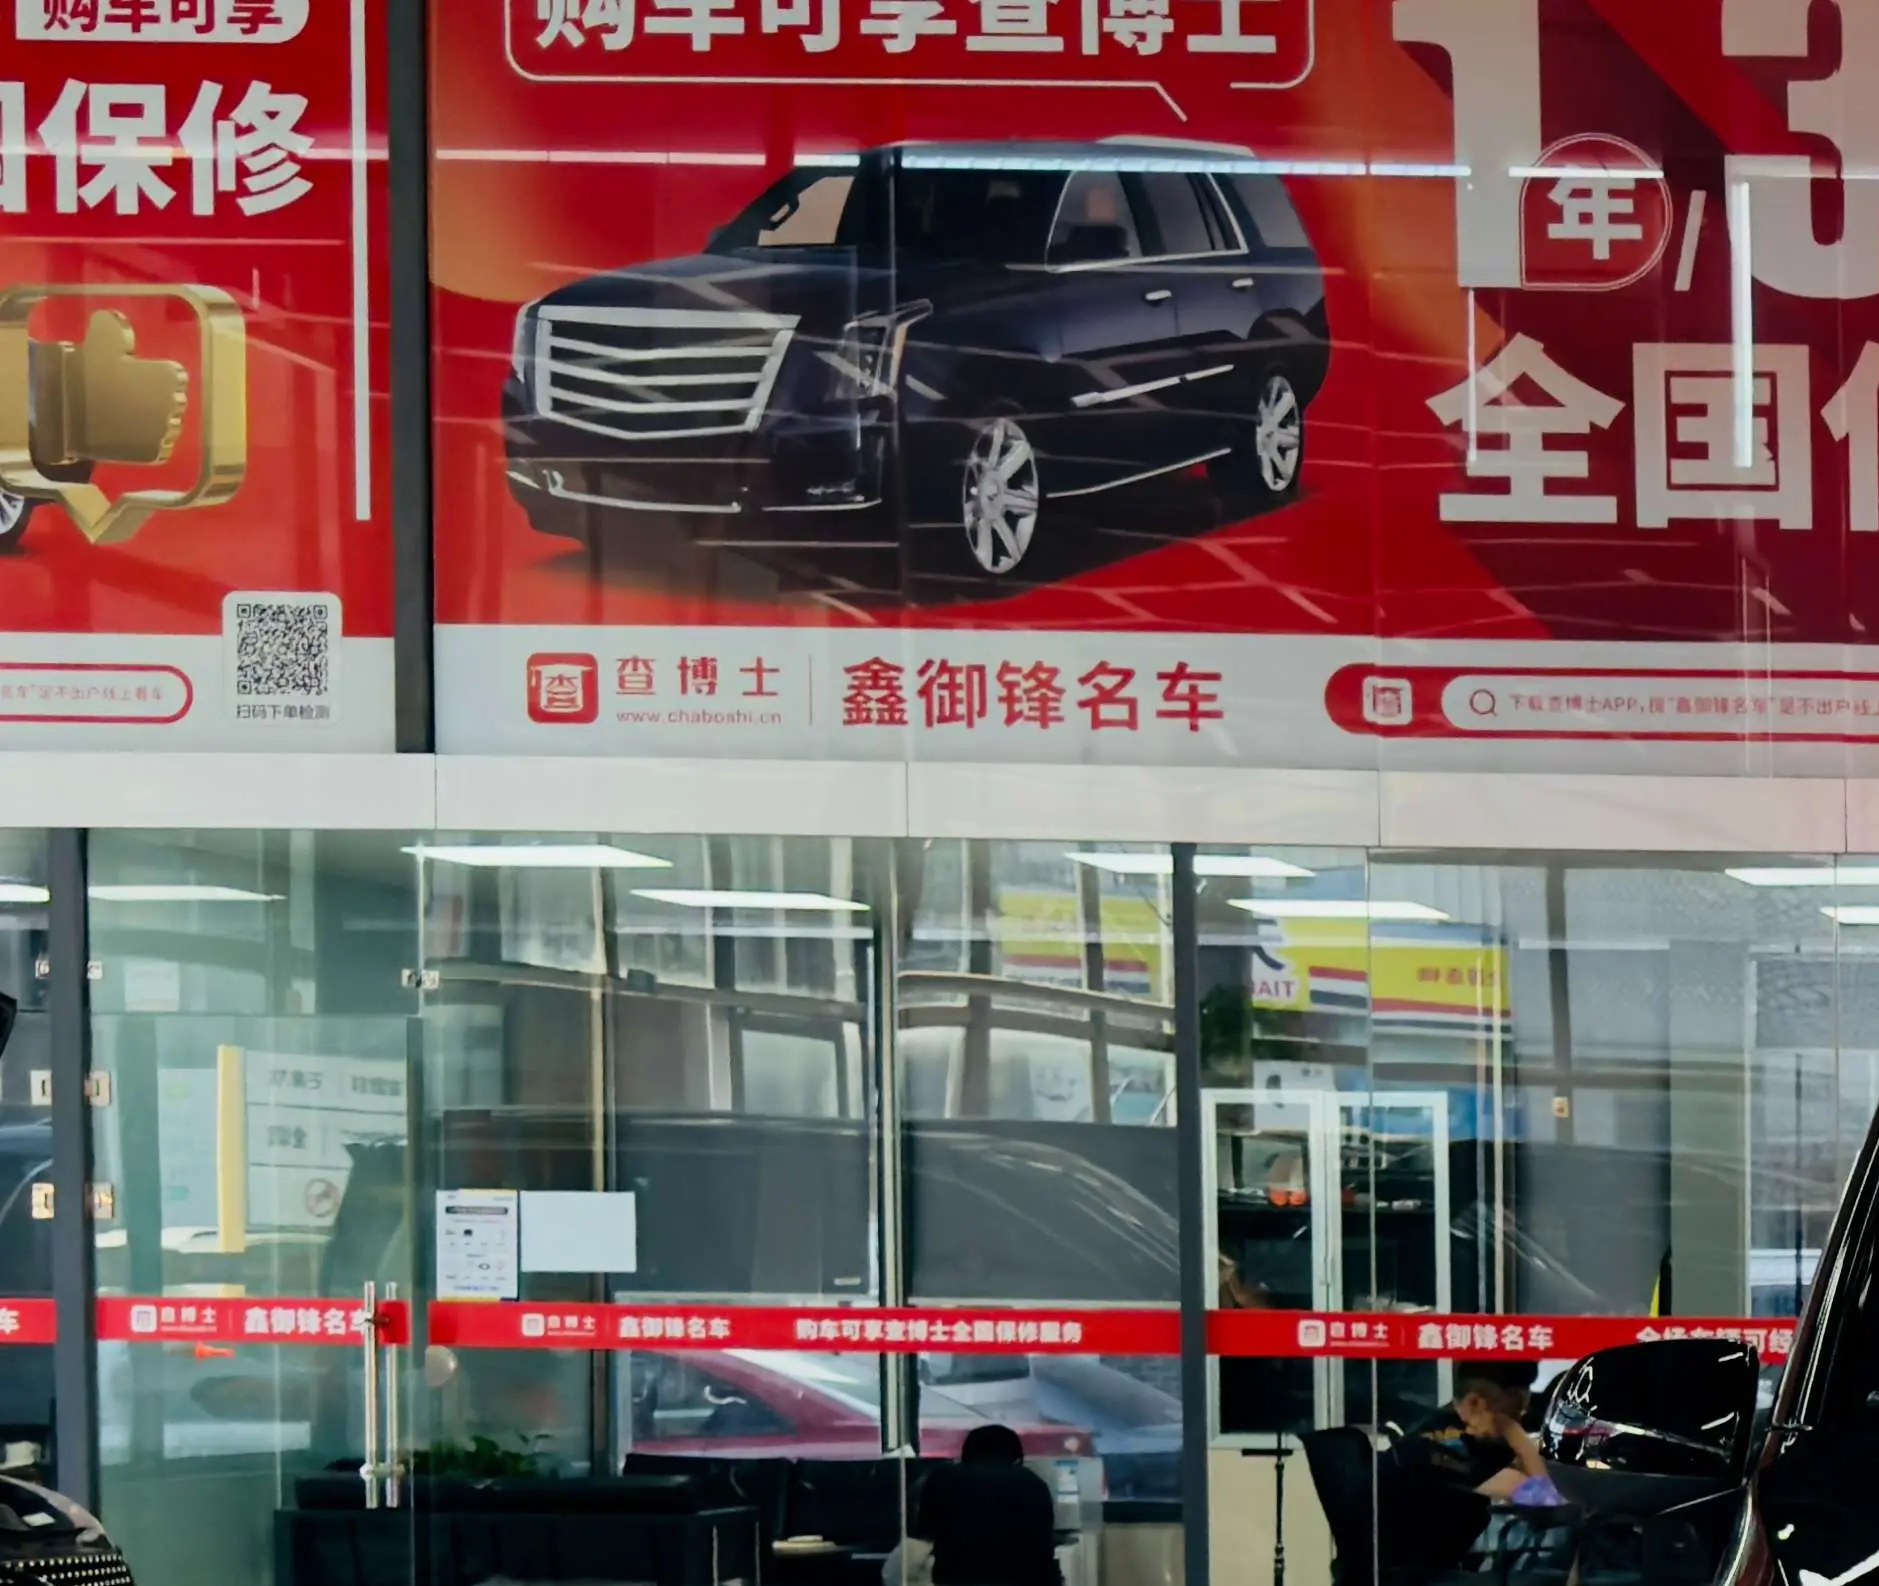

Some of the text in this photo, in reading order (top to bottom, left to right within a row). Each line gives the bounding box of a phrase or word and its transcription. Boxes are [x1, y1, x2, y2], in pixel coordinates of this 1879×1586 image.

[0, 77, 315, 217] 保修
[843, 656, 1225, 733] 鑫御锋名车
